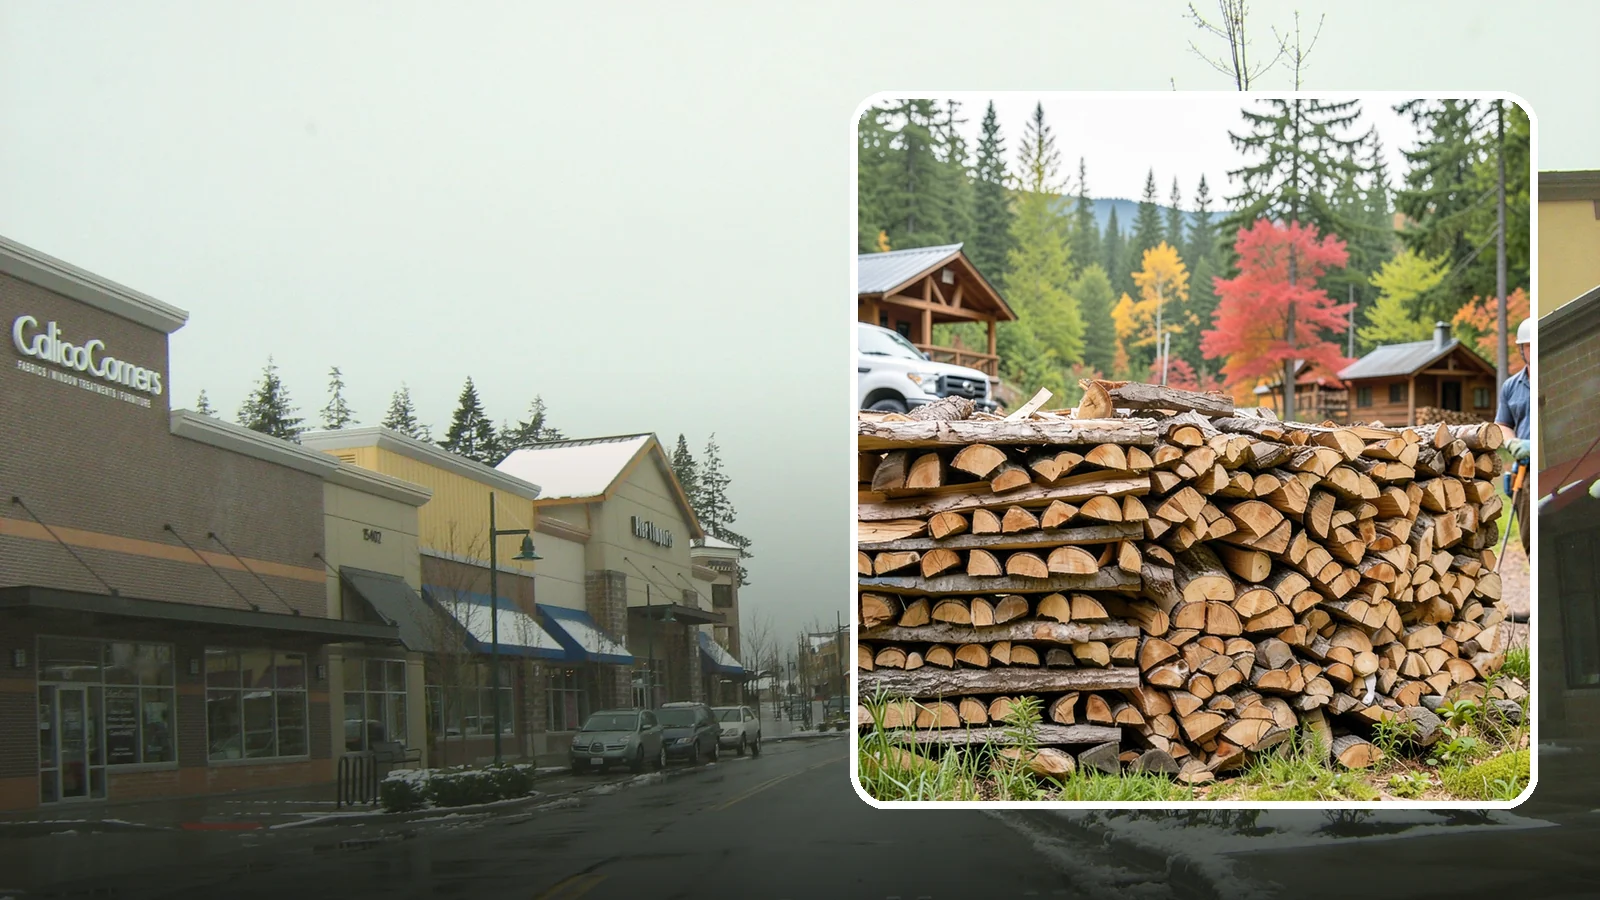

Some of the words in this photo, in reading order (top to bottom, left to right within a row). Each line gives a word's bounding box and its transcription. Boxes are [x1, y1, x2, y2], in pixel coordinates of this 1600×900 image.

[16, 360, 47, 377] FABRICS
[51, 370, 78, 386] WINDOW
[79, 378, 116, 398] TREATMENTS
[120, 391, 151, 408] FURNITURE
